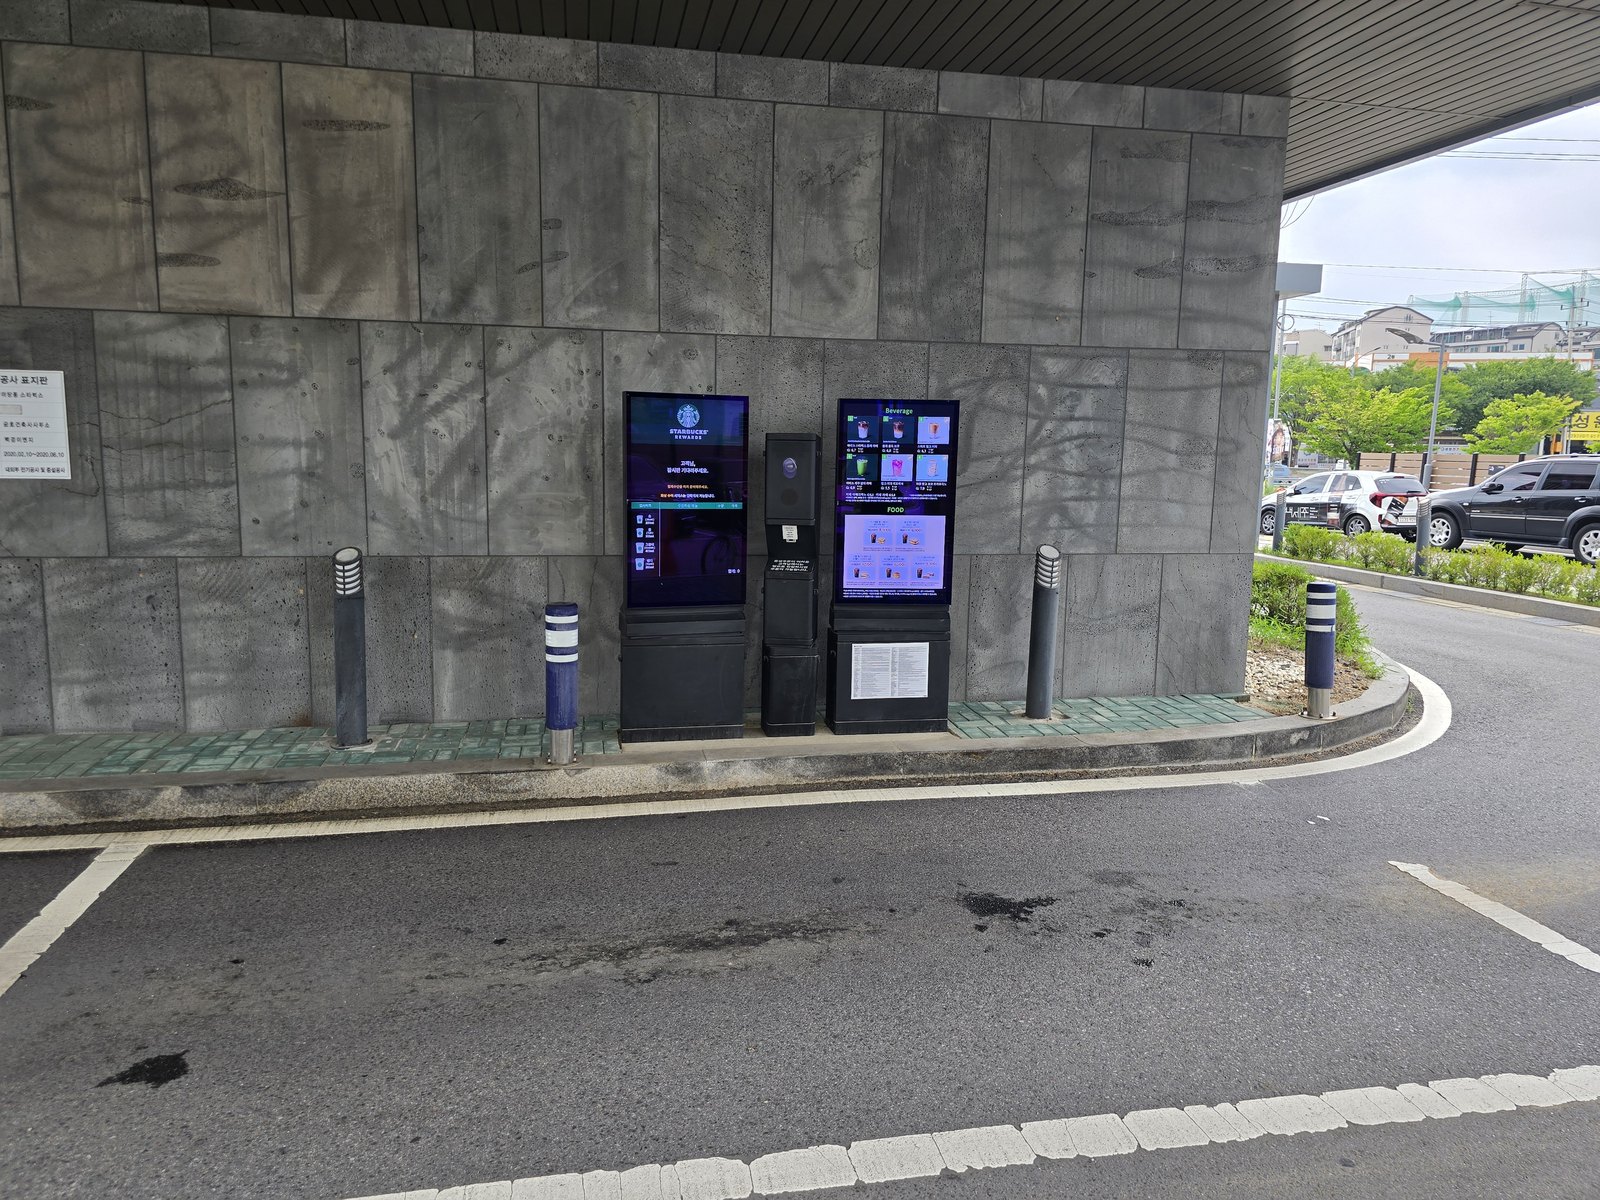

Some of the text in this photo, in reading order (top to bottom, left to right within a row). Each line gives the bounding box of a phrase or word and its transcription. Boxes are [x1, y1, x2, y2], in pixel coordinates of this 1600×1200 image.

[0, 375, 48, 385] 공사 표지판
[885, 407, 914, 415] Beverage
